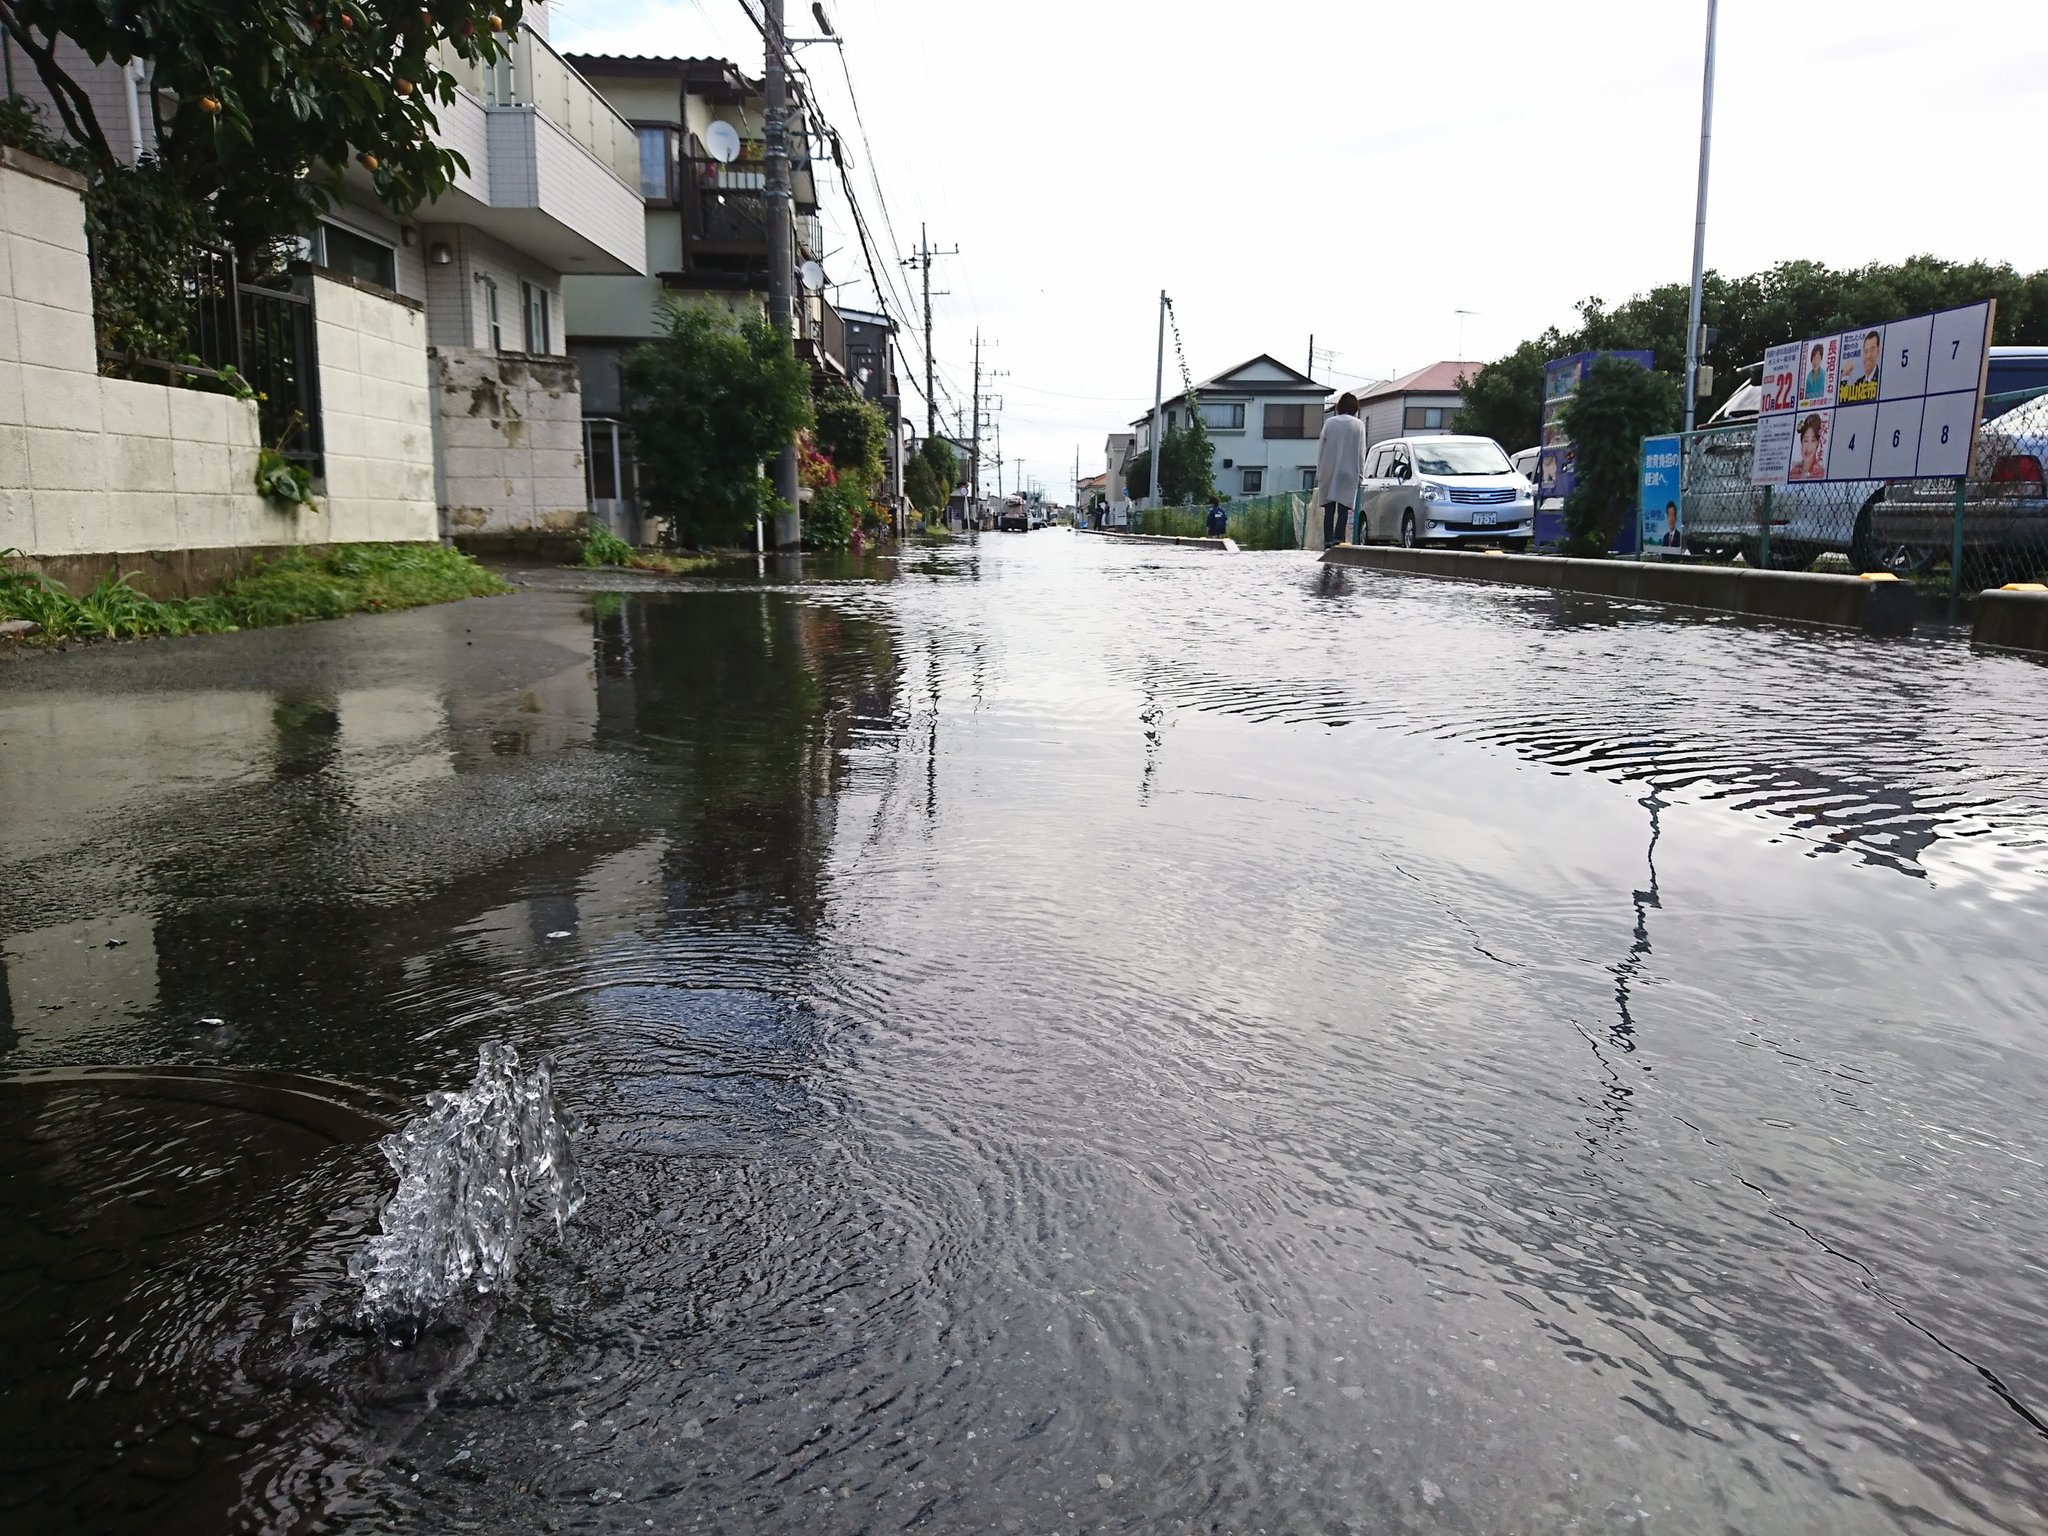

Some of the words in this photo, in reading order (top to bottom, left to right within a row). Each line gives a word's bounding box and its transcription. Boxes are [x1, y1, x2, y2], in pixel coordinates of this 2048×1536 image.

[1901, 349, 1909, 368] 5
[1951, 340, 1960, 359] 7
[1840, 381, 1877, 402] 神山佐市
[1848, 433, 1856, 451] 4
[1892, 430, 1900, 448] 6
[1940, 425, 1948, 444] 8
[1645, 453, 1679, 468] 教育負担の
